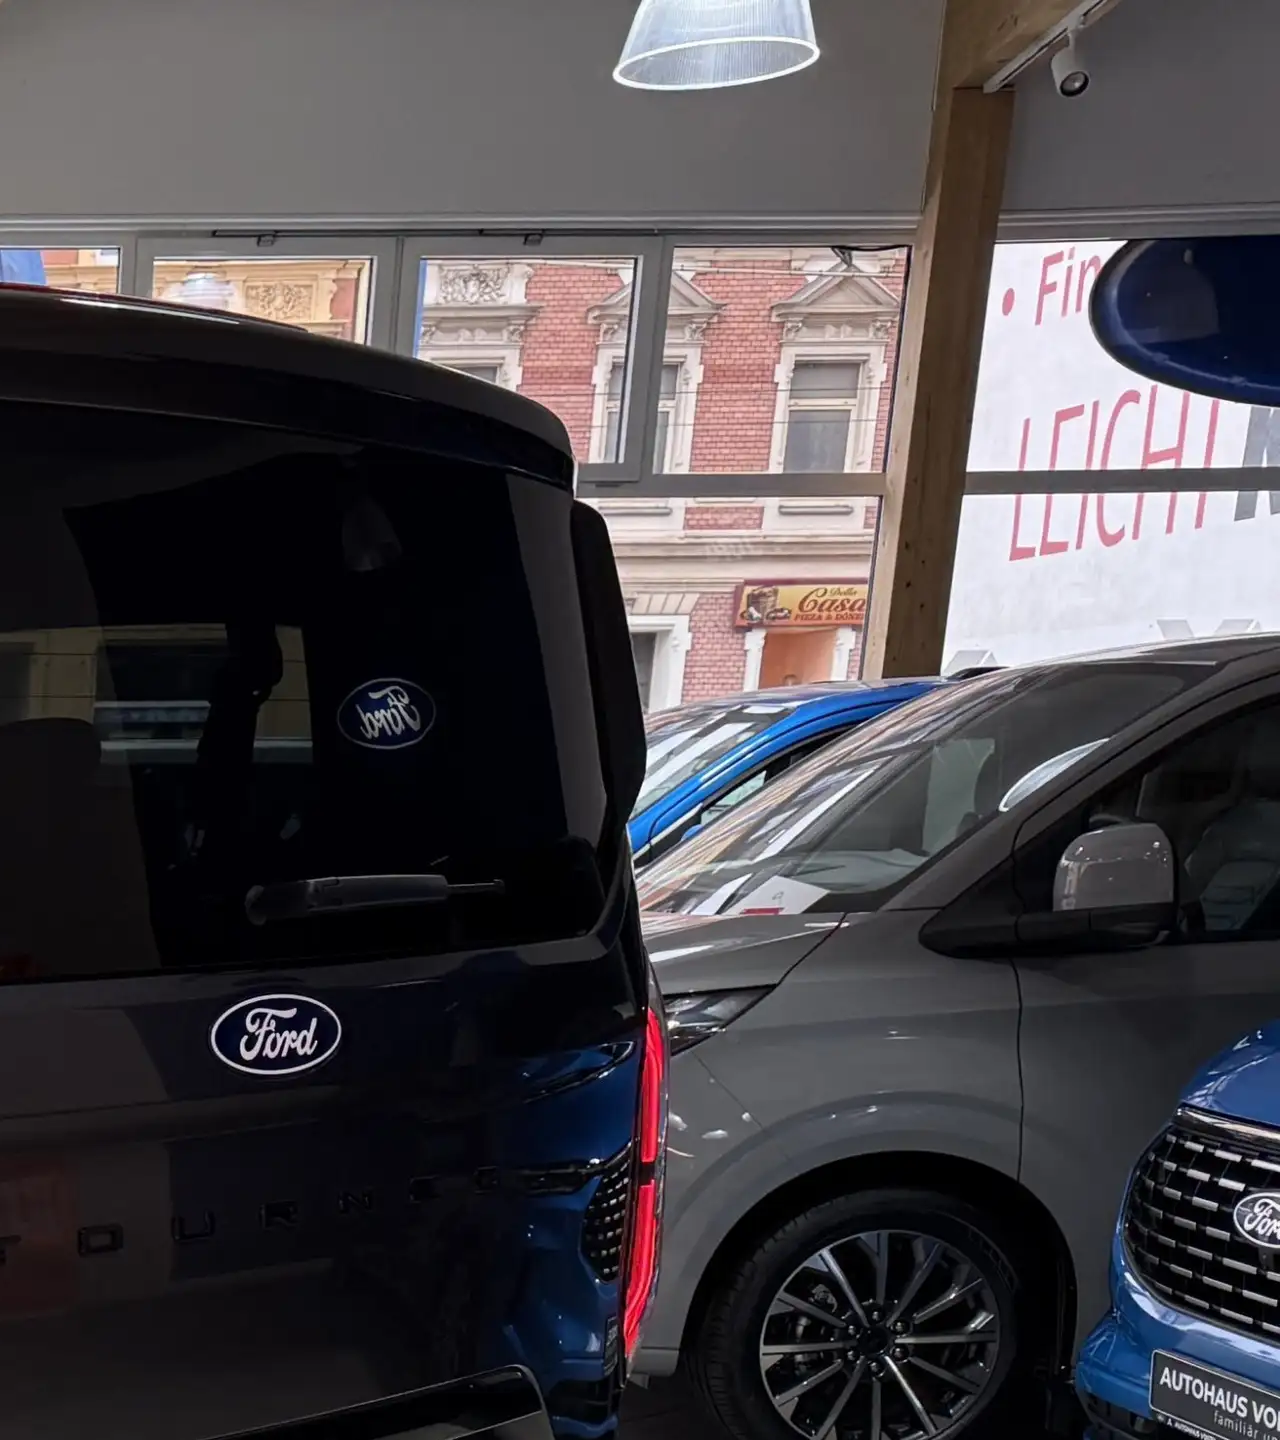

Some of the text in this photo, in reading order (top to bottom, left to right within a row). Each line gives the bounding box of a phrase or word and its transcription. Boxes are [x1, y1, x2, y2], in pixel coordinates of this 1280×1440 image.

[239, 1006, 319, 1061] Ford
[1159, 1366, 1249, 1419] AUTOHAUS
[1213, 1410, 1260, 1440] familiär
